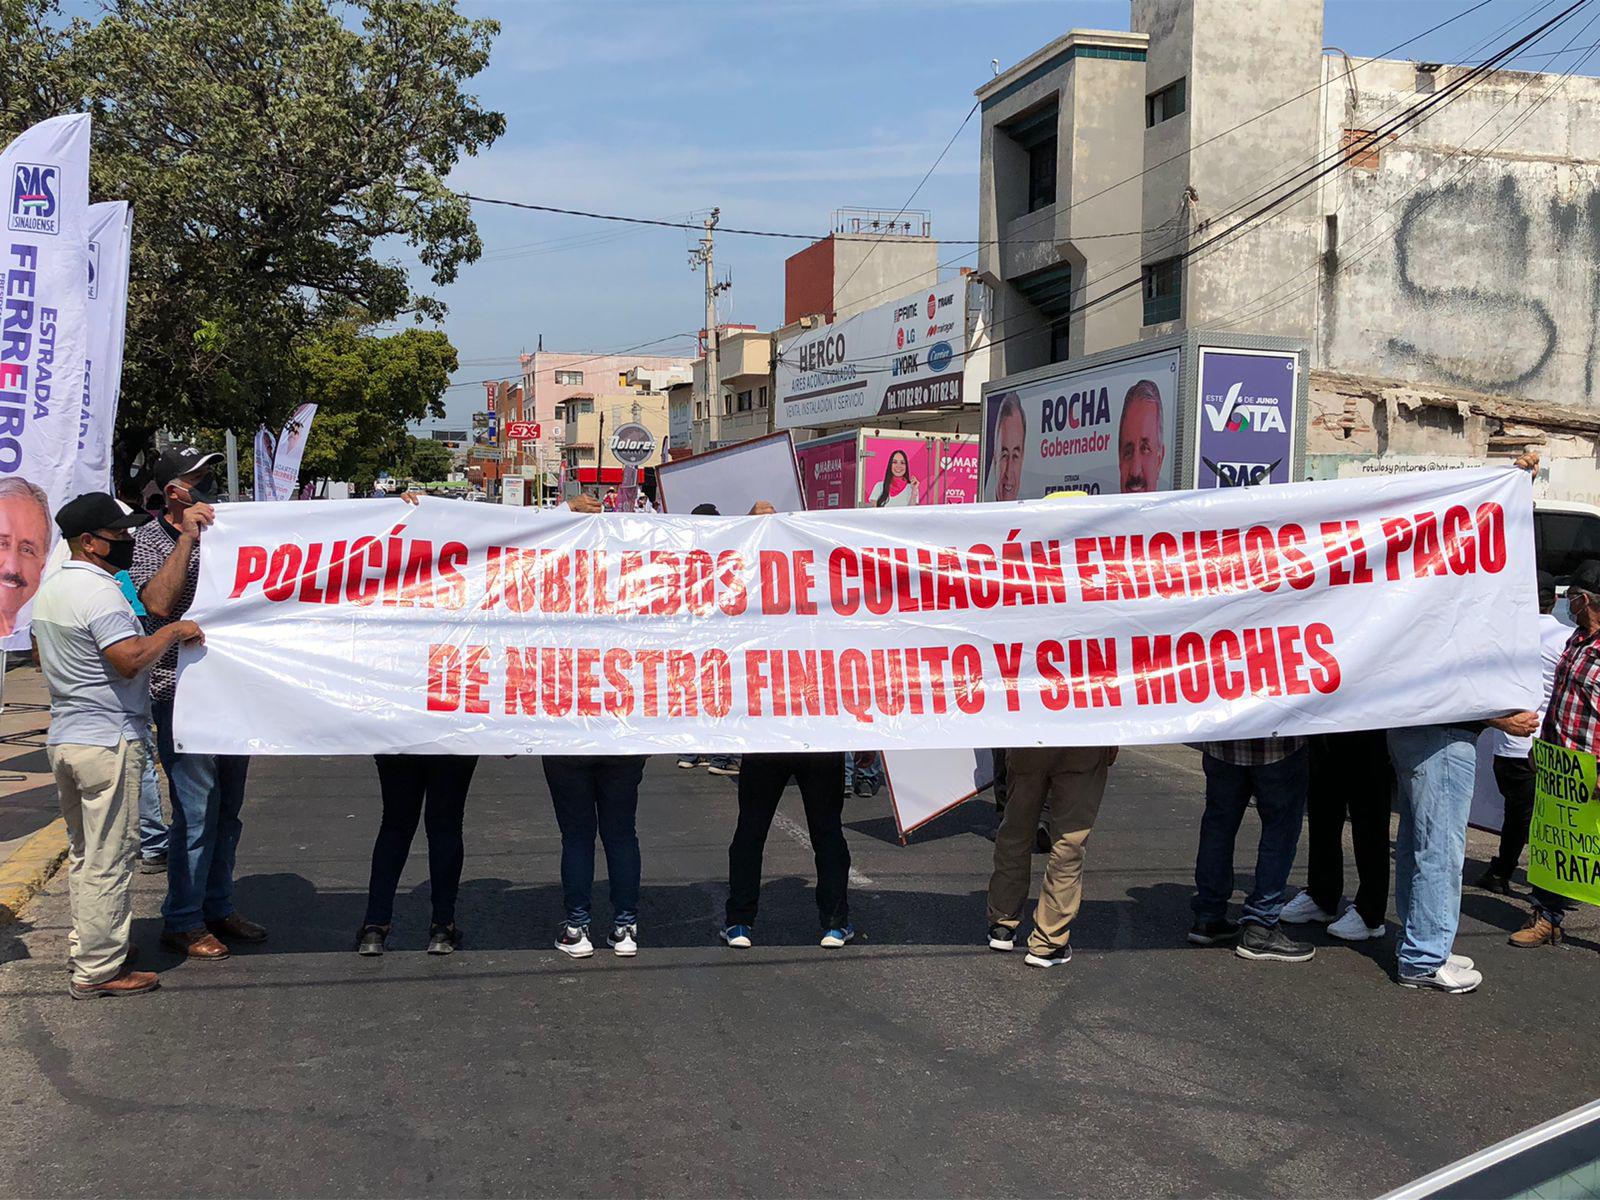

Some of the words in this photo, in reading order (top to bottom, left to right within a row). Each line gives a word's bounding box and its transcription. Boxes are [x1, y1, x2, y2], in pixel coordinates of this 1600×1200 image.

[14, 216, 55, 232] SINALOENSE
[800, 333, 845, 373] HERCO
[906, 328, 916, 344] LG
[0, 244, 38, 473] FERREIRO
[33, 307, 57, 420] ESTRADA
[899, 353, 919, 376] YORK
[1041, 387, 1110, 433] ROCHA
[1204, 382, 1287, 433] VOTA
[1206, 395, 1223, 403] ESTE
[608, 435, 658, 450] Dolores
[1040, 432, 1111, 458] Gobernador
[228, 524, 469, 611] POLICÍAS
[482, 546, 747, 616] JUBILADOS
[759, 550, 818, 616] DE
[828, 528, 1067, 616] CULIACÁN
[1075, 523, 1314, 604] EXIGIMOS
[1320, 519, 1374, 587] EL
[1380, 502, 1507, 582] PAGO
[426, 643, 490, 714] DE
[504, 646, 733, 718] NUESTRO
[744, 643, 983, 723] FINIQUITO
[993, 642, 1023, 711] Y
[1036, 635, 1123, 711] SIN
[1131, 622, 1342, 706] MOCHES
[1535, 740, 1584, 779] ESTRADA
[1556, 803, 1579, 828] TE
[1532, 817, 1600, 856] QUEREMOS
[1530, 844, 1551, 871] POR
